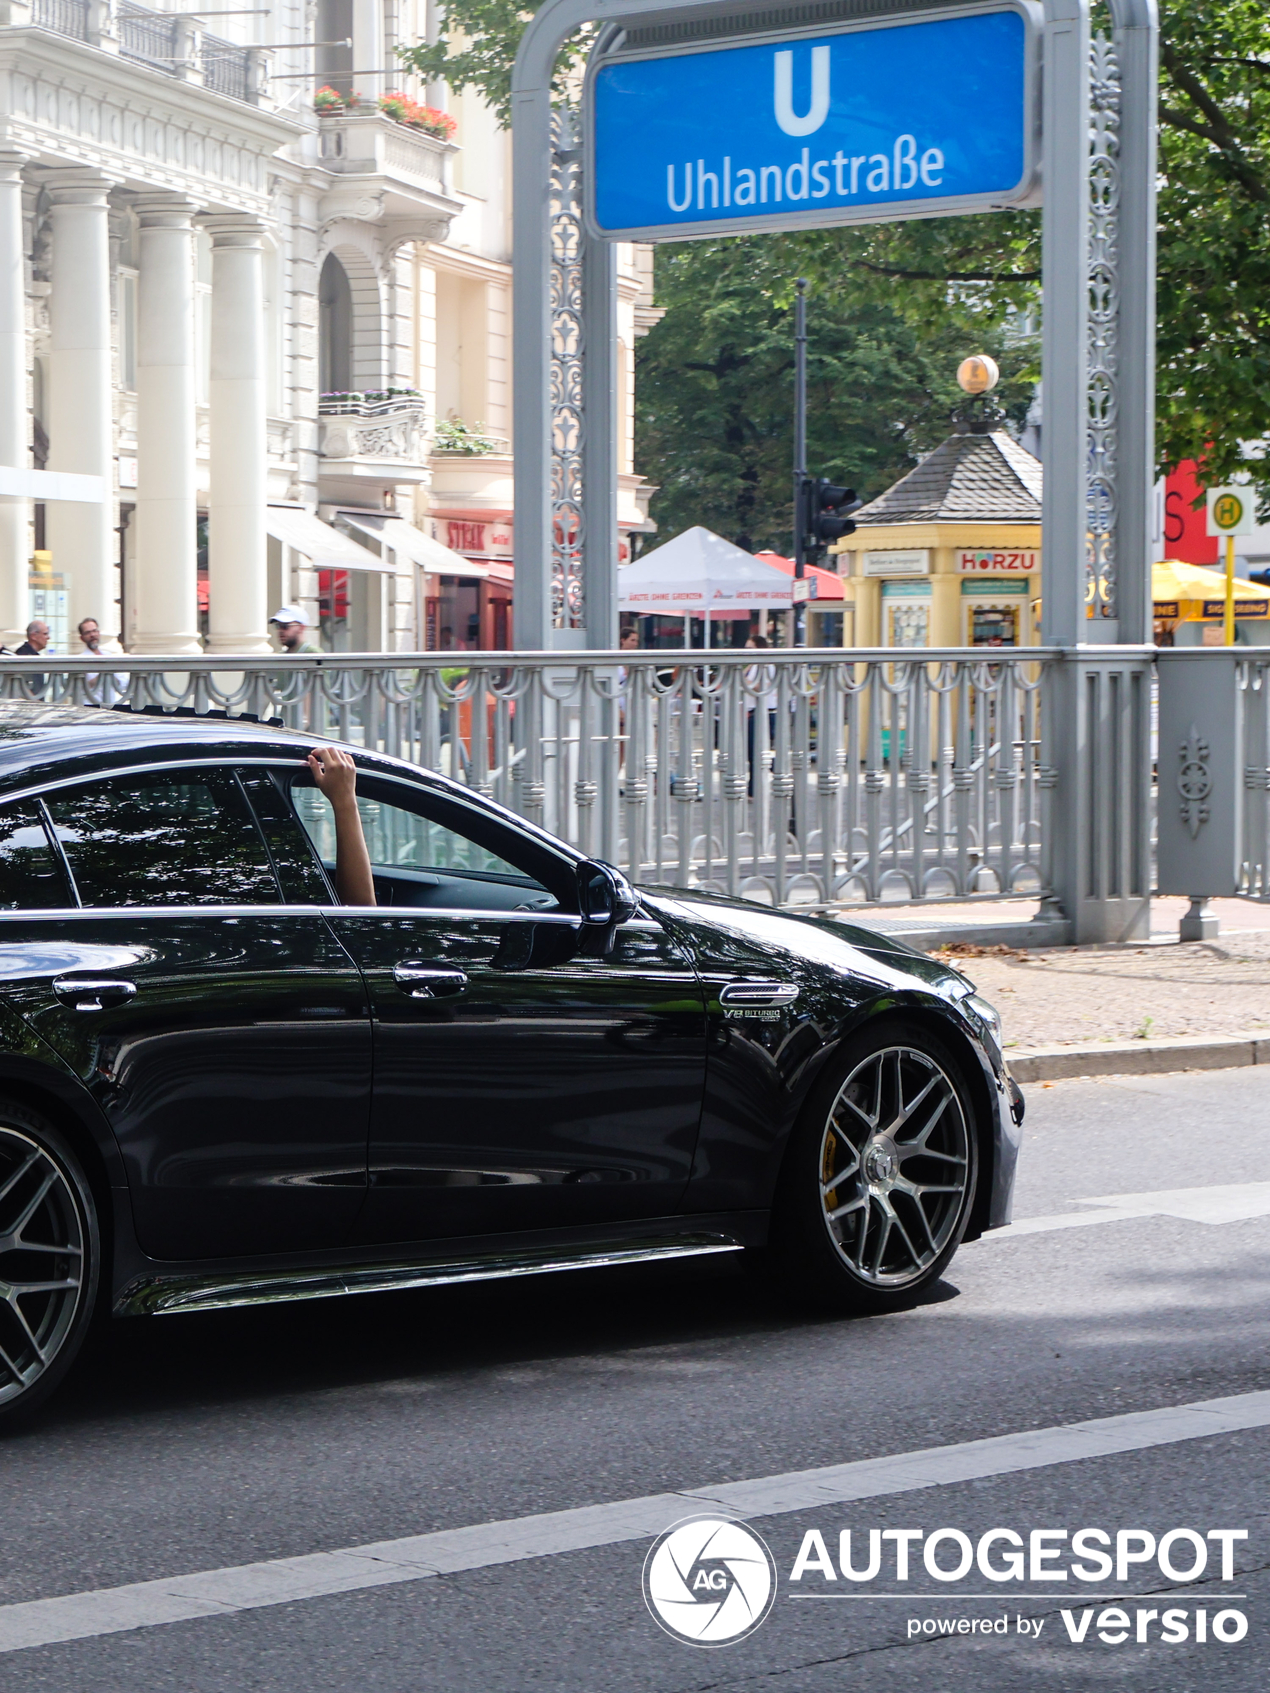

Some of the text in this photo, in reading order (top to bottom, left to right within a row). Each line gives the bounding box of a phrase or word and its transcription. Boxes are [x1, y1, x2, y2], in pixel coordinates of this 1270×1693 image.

[773, 45, 830, 137] U
[665, 133, 945, 213] Uhlandstraße
[723, 1009, 781, 1019] V8 BITURBO
